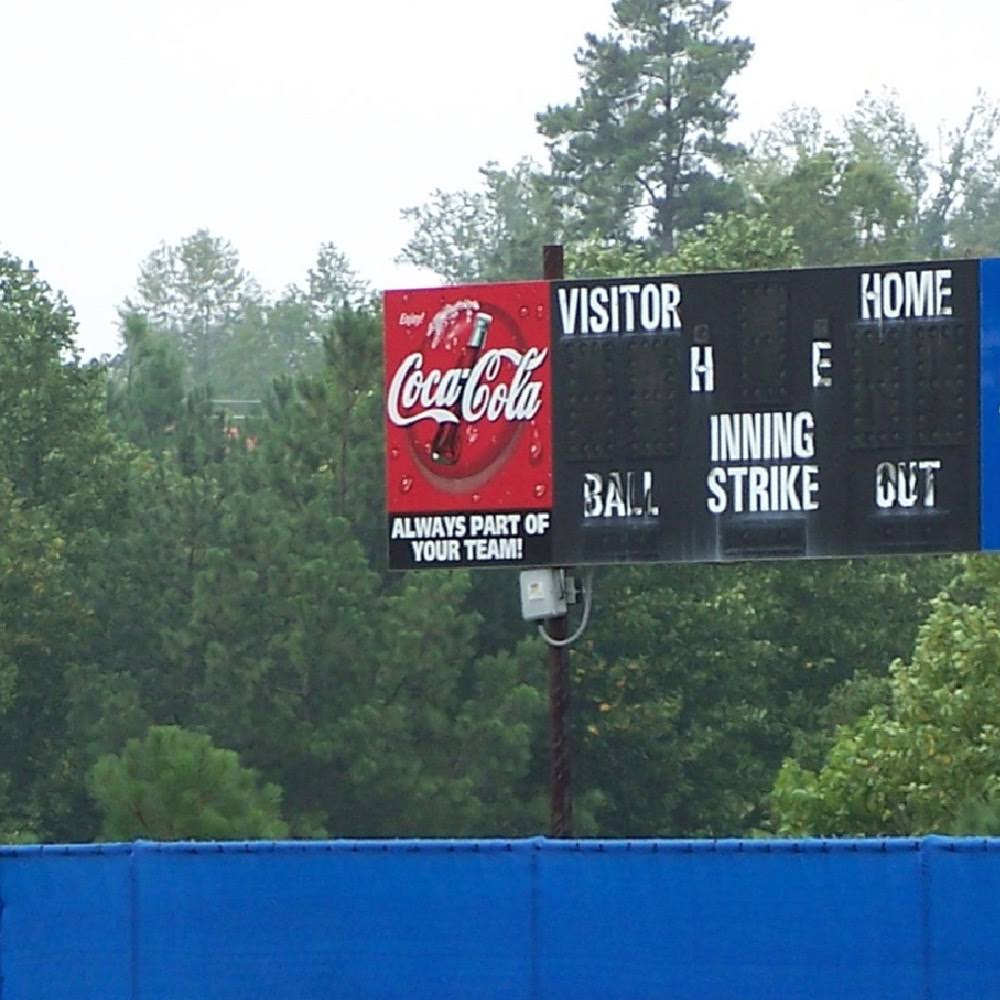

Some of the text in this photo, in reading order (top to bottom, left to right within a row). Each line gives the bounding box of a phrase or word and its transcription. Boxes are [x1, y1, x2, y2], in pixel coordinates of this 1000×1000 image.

[558, 283, 682, 335] VISITOR
[860, 269, 952, 319] HOME
[690, 346, 714, 392] H
[812, 341, 832, 387] E
[710, 411, 815, 462] INNING
[583, 470, 659, 518] BALL
[707, 464, 819, 514] STRIKE
[875, 461, 941, 508] OUT
[391, 512, 550, 540] ALWAYS PART OF
[412, 537, 523, 562] YOUR TEAM!
